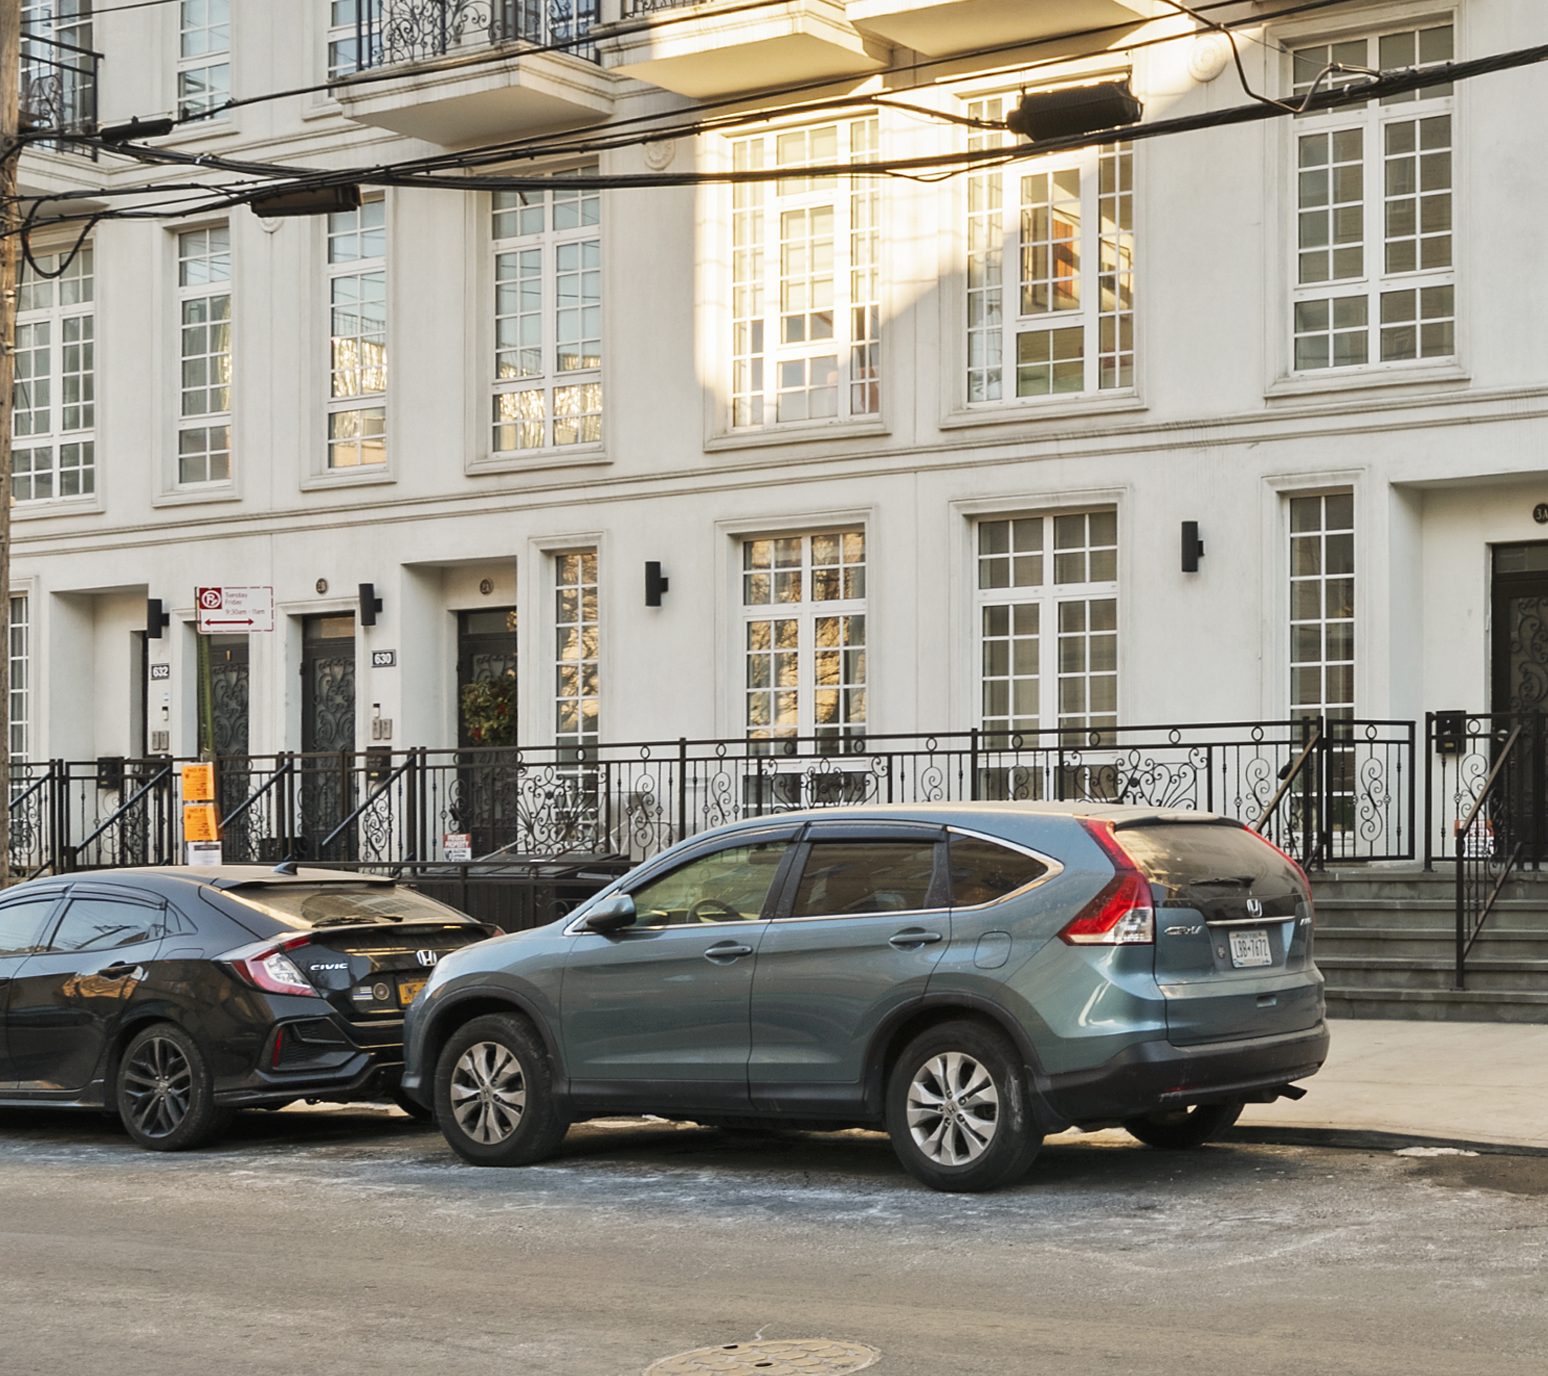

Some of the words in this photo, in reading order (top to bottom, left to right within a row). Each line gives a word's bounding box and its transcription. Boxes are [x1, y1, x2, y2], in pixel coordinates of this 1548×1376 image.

[1535, 509, 1548, 521] 3A
[225, 592, 248, 600] Tuesday
[374, 653, 392, 664] 630
[152, 666, 169, 677] 632
[310, 962, 348, 970] CIVIC
